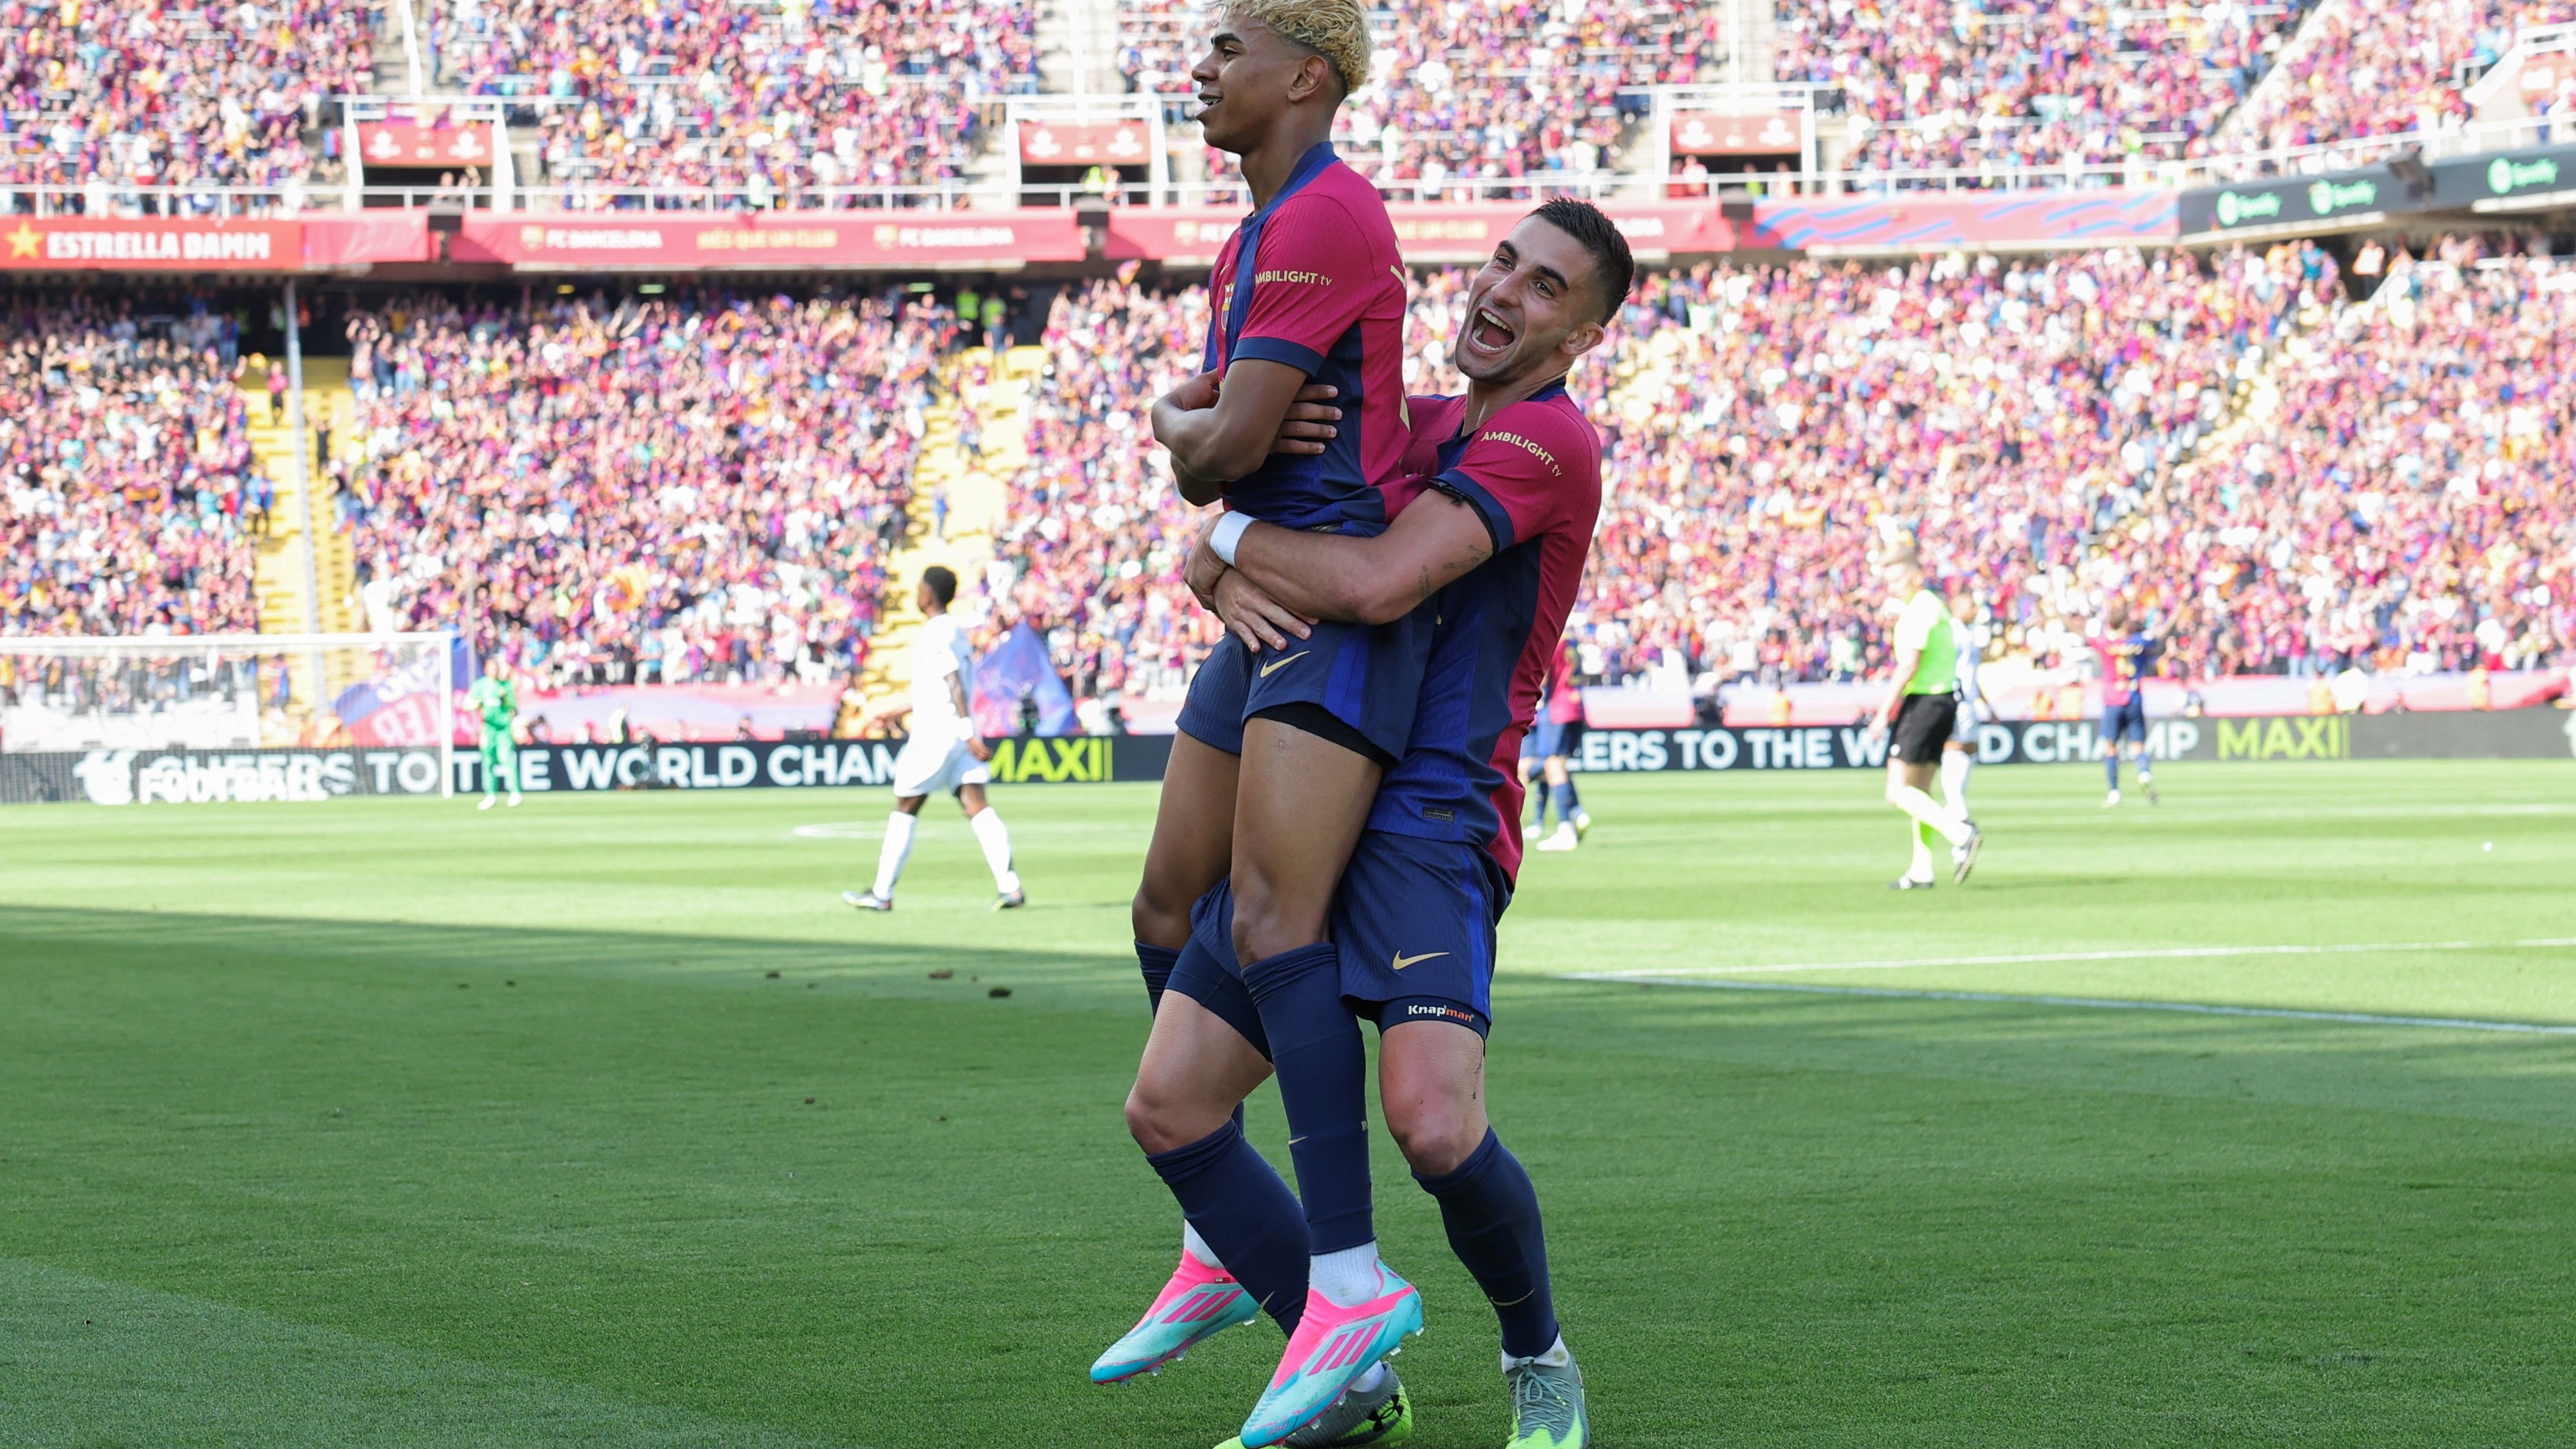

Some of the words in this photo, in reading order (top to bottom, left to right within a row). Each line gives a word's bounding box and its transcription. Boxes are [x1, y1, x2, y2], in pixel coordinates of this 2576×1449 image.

[47, 232, 179, 259] ESTRELLA
[183, 232, 270, 259] DAMM
[1255, 270, 1318, 285] AMBILIGHT
[1320, 275, 1333, 287] tv
[1481, 431, 1554, 466] AMBILIGHT
[1551, 464, 1562, 477] tv
[1674, 730, 1739, 770] TO
[1743, 728, 1833, 768] THE
[2218, 716, 2342, 761] MAXI
[365, 751, 438, 793] TO
[562, 746, 758, 789] WORLD
[767, 743, 906, 787] CHAM
[990, 737, 1103, 783] MAXI
